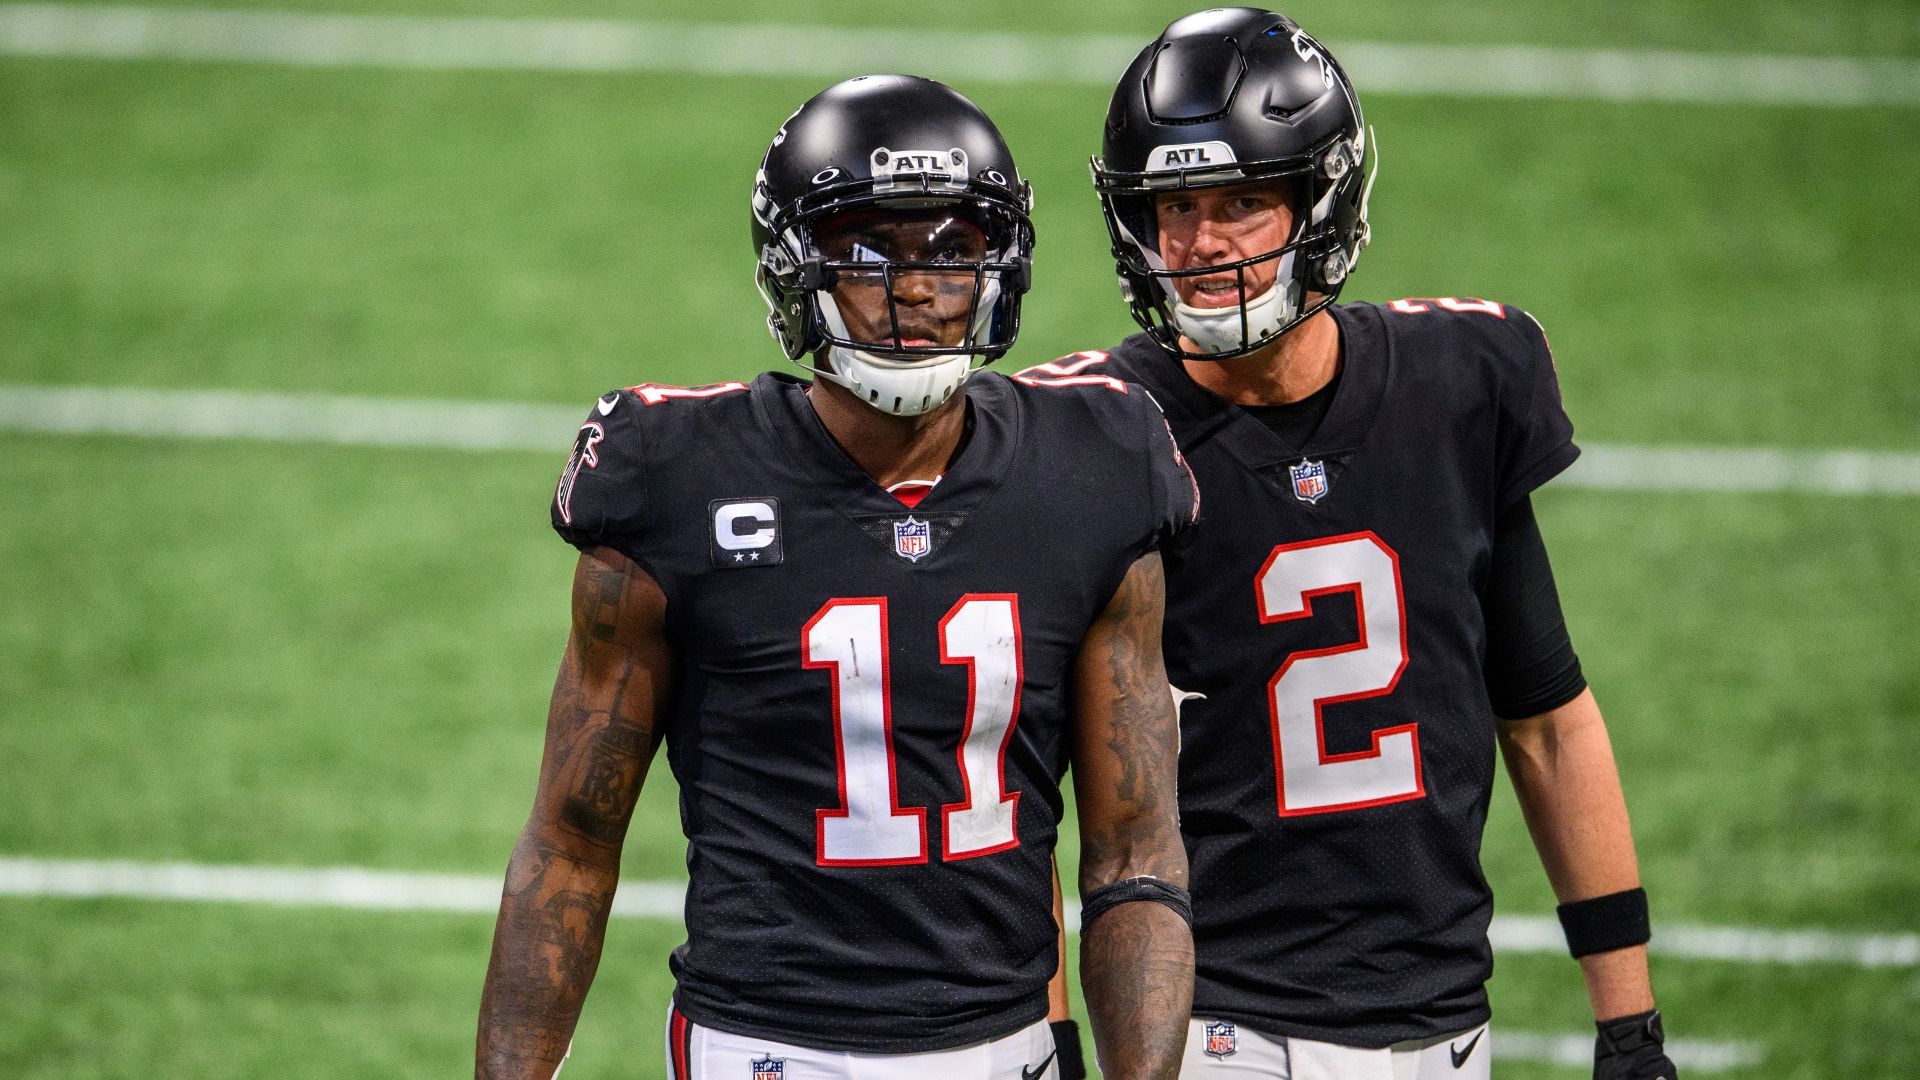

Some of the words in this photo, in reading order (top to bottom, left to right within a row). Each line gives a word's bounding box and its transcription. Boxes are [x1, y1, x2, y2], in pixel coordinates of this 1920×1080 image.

[895, 155, 944, 171] ATL
[1164, 147, 1211, 165] ATL
[1297, 478, 1323, 496] NFL
[714, 502, 776, 551] C
[900, 536, 926, 554] NFL
[1253, 530, 1427, 818] 2
[800, 592, 1025, 867] 11
[1208, 1036, 1234, 1052] NFL
